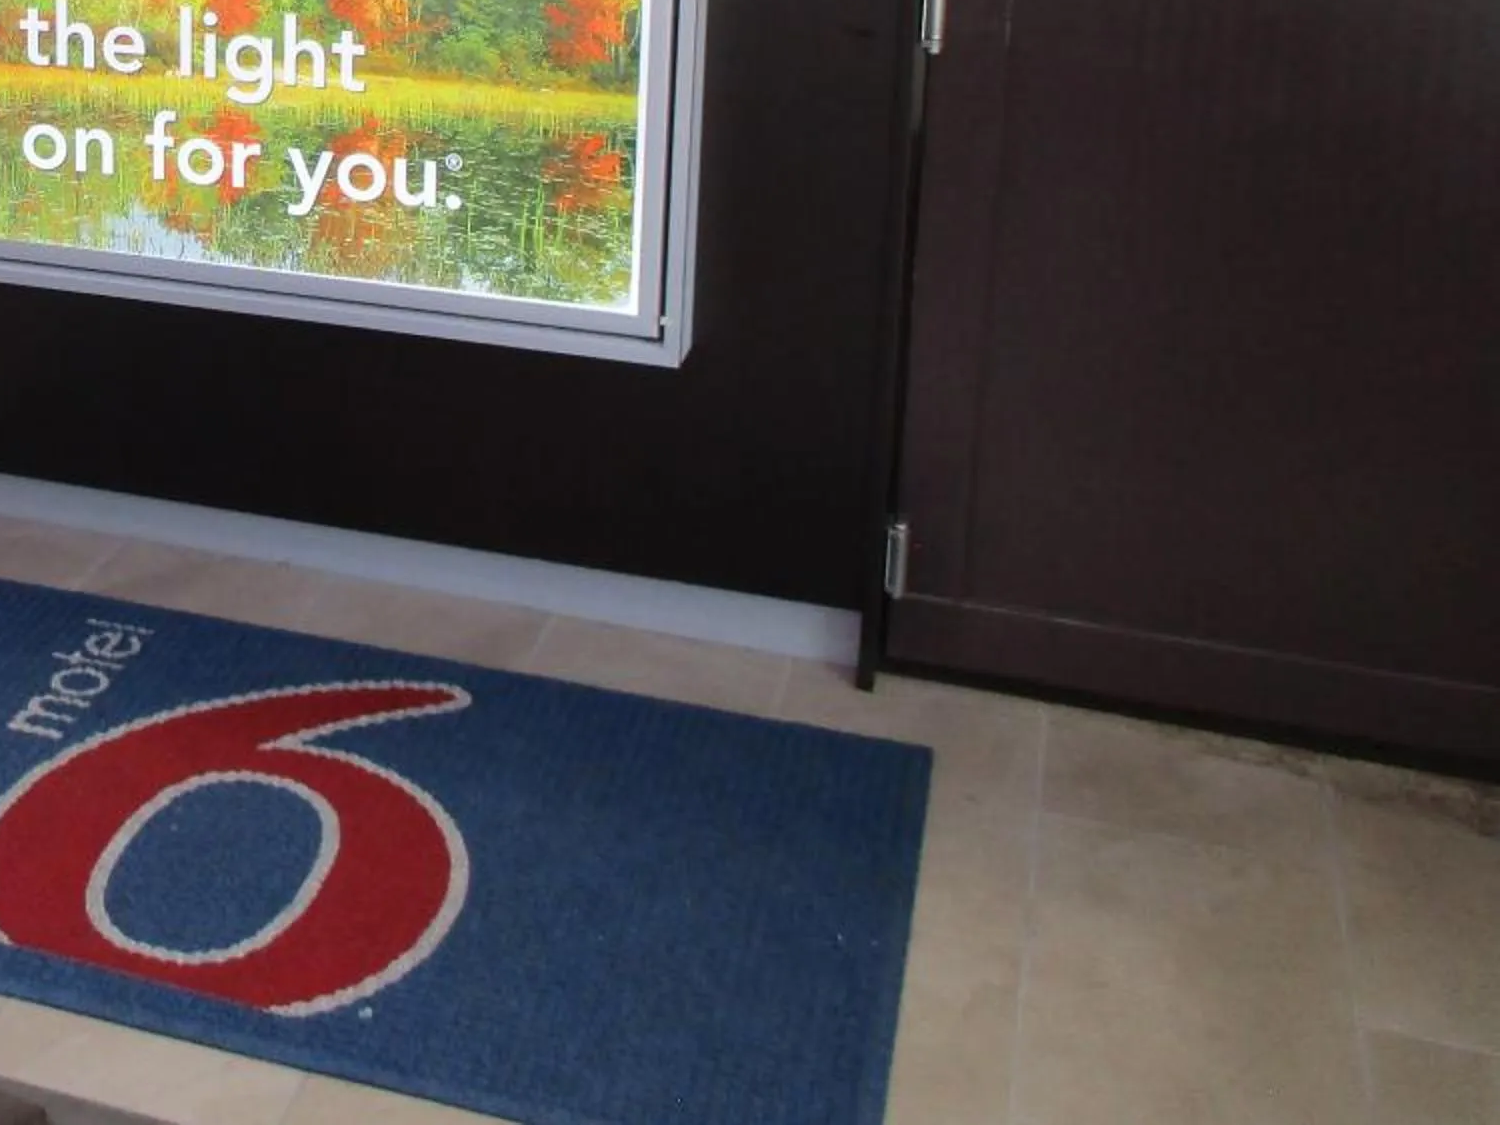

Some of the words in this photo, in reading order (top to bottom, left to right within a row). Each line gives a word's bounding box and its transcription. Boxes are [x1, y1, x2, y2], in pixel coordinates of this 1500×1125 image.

[178, 4, 366, 104] light
[22, 121, 114, 175] on
[145, 110, 261, 188] for
[6, 618, 156, 739] motel
